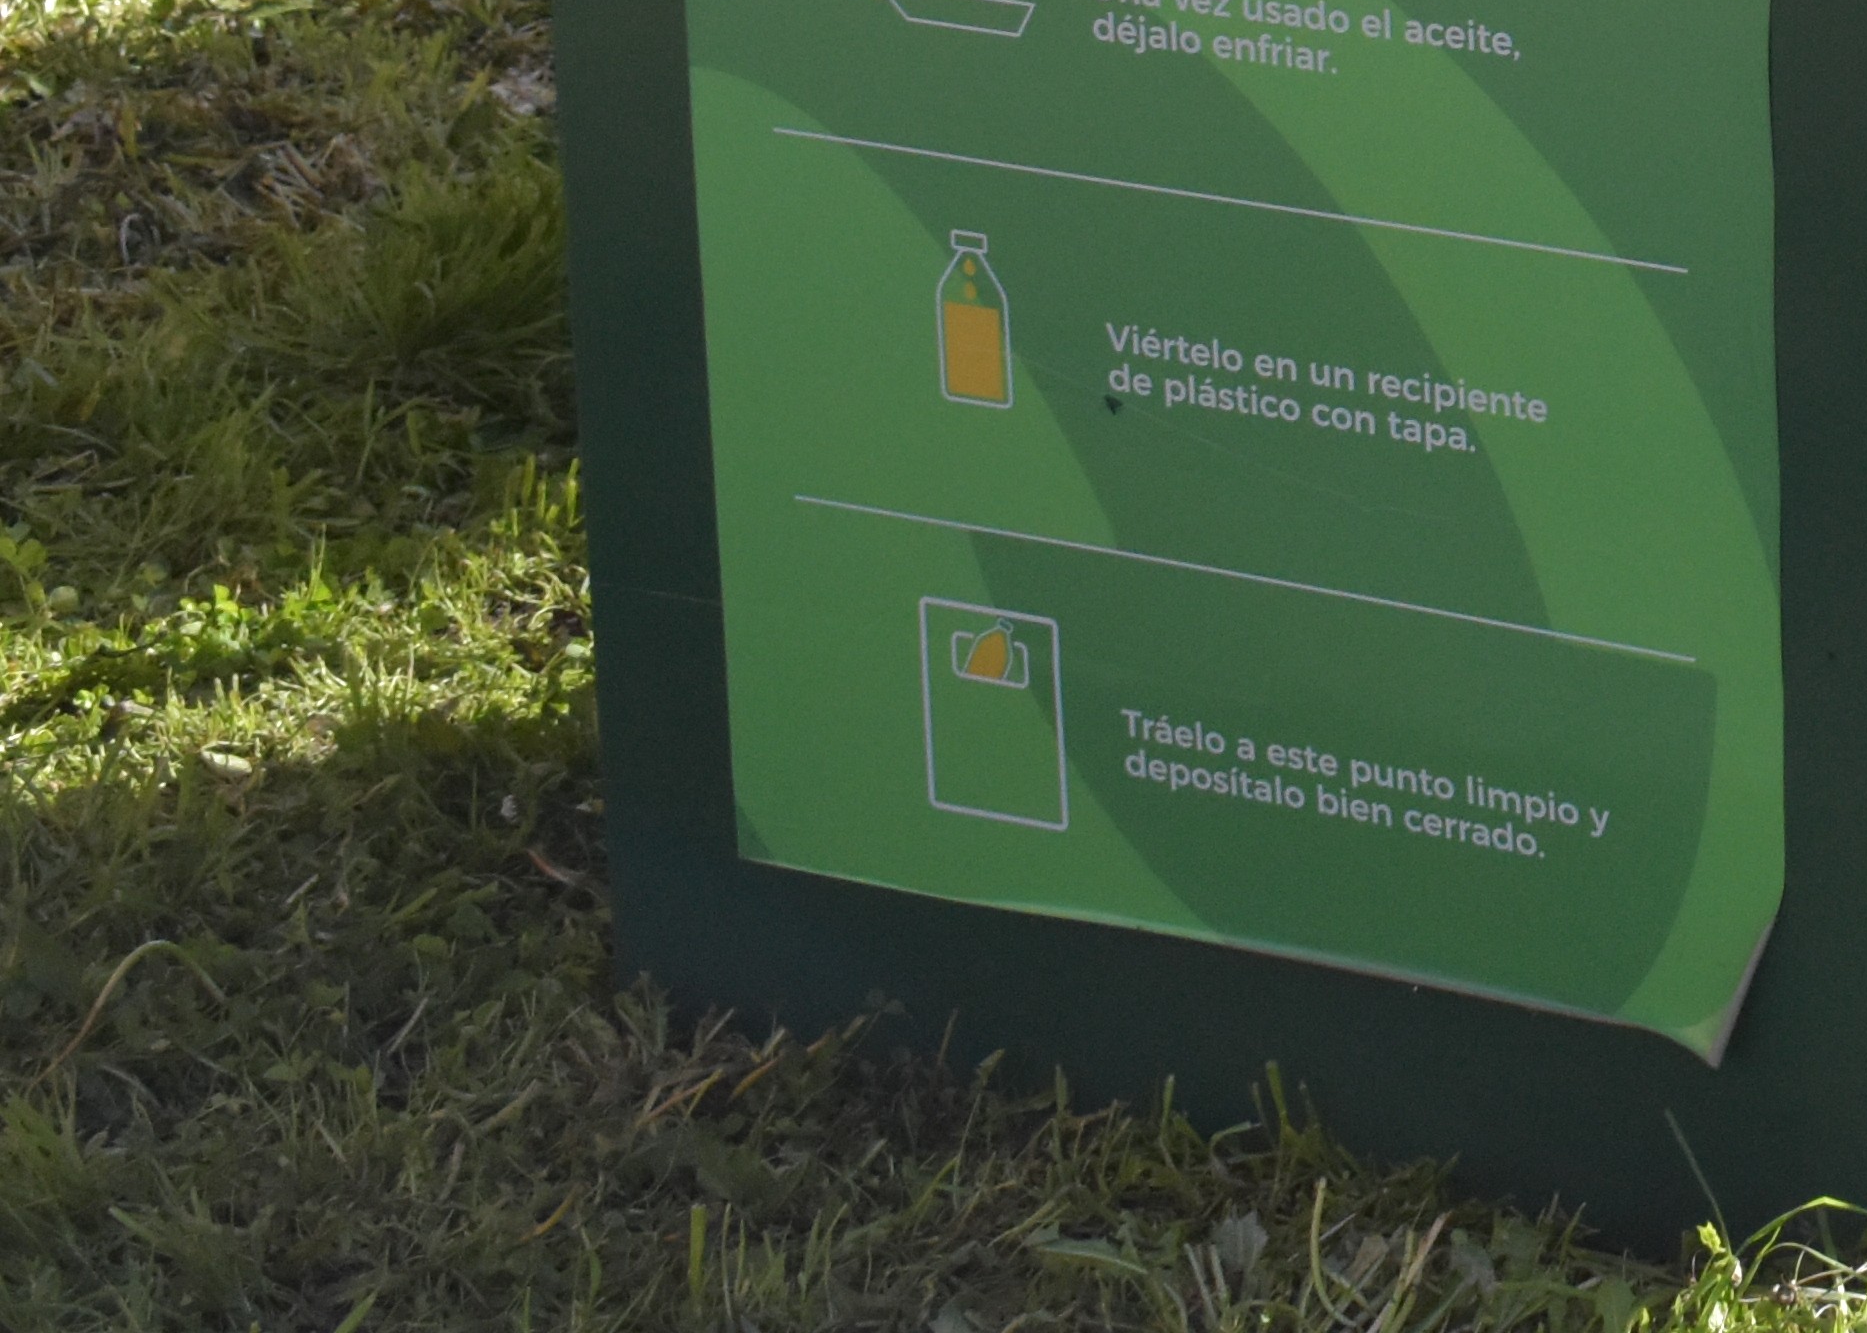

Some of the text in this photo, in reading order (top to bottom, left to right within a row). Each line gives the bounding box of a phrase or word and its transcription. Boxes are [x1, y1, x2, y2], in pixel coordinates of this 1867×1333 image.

[1093, 12, 1338, 74] déjalo enfriar.
[1361, 8, 1391, 39] el
[1404, 20, 1520, 59] aceite,
[1106, 323, 1548, 423] Viértelo en un recipiente
[1109, 364, 1476, 453] de plástico con tapa.
[1121, 709, 1609, 837] Tráelo a este punto limpio y
[1125, 749, 1546, 858] deposítalo bien cerrado.
